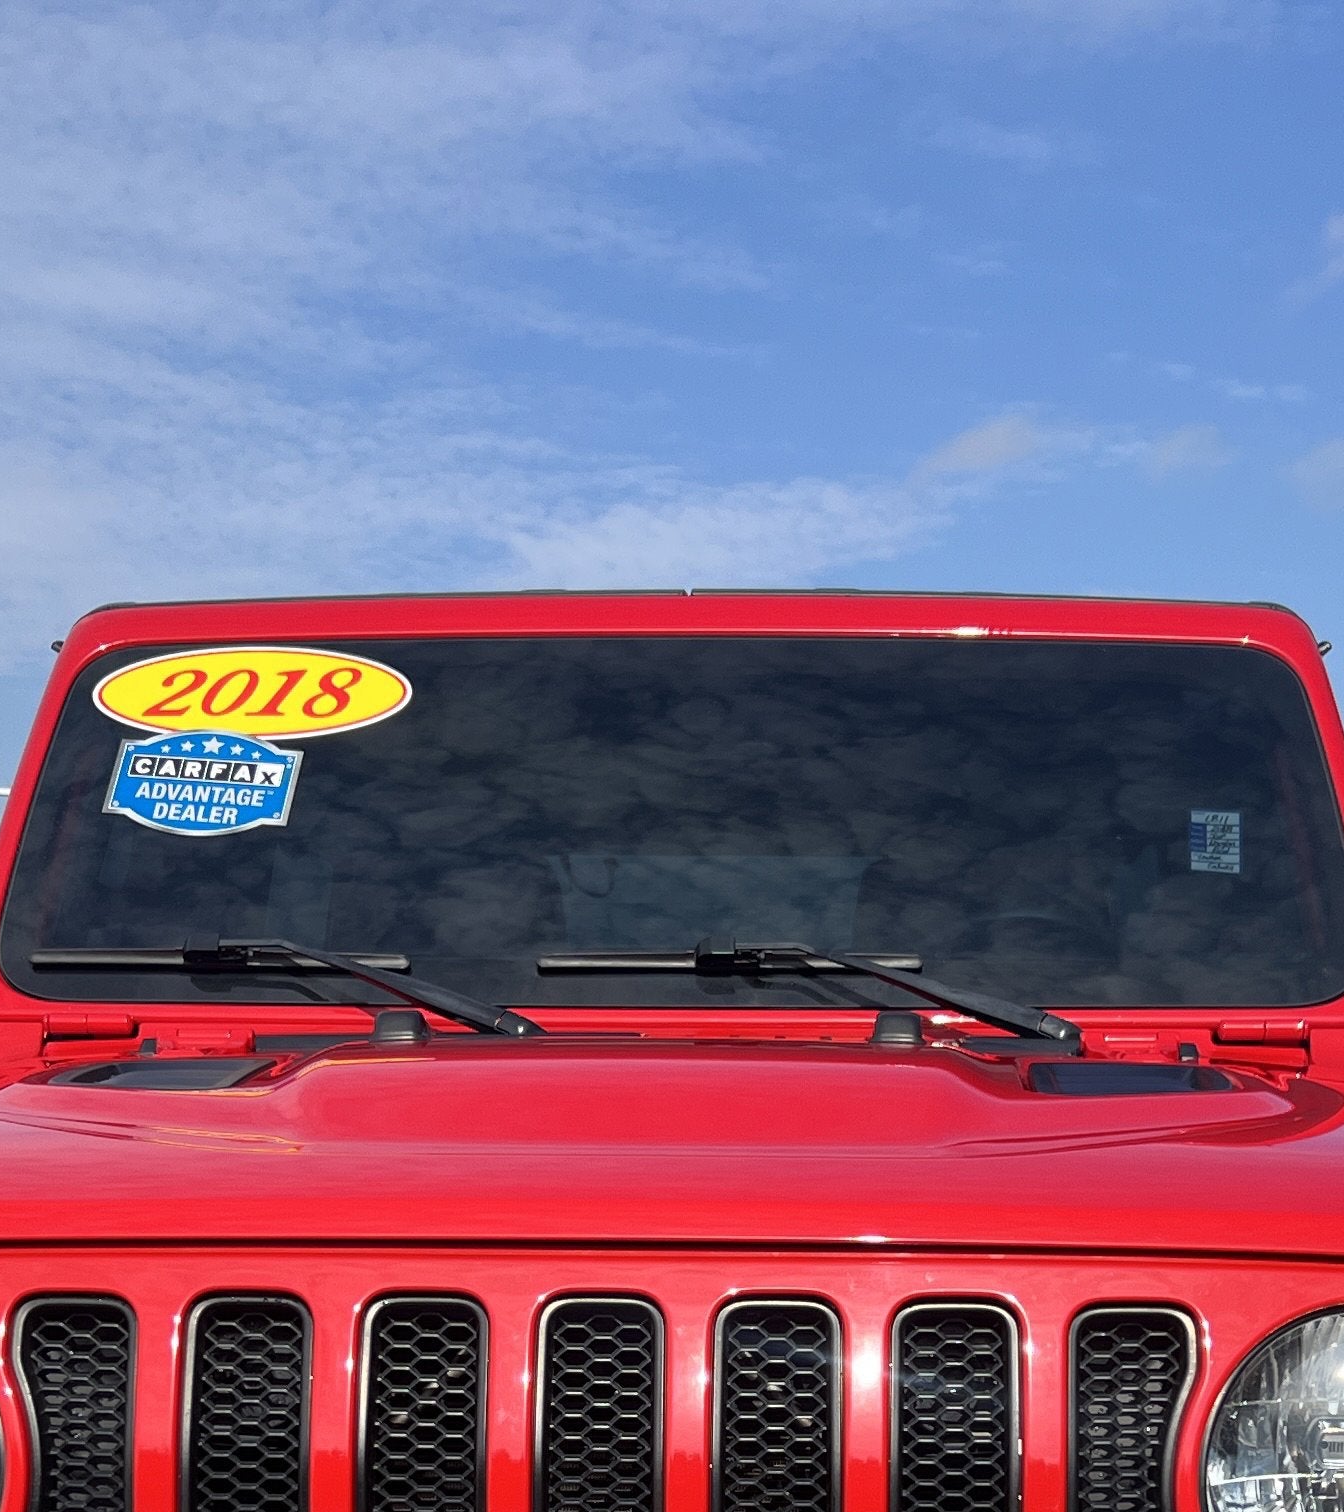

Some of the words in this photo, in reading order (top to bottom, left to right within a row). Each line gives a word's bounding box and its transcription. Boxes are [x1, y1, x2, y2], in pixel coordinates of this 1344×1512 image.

[142, 668, 363, 718] 2018
[133, 757, 278, 786] CARFAX
[135, 781, 266, 808] ADVANTAGE
[152, 802, 239, 826] DEALER
